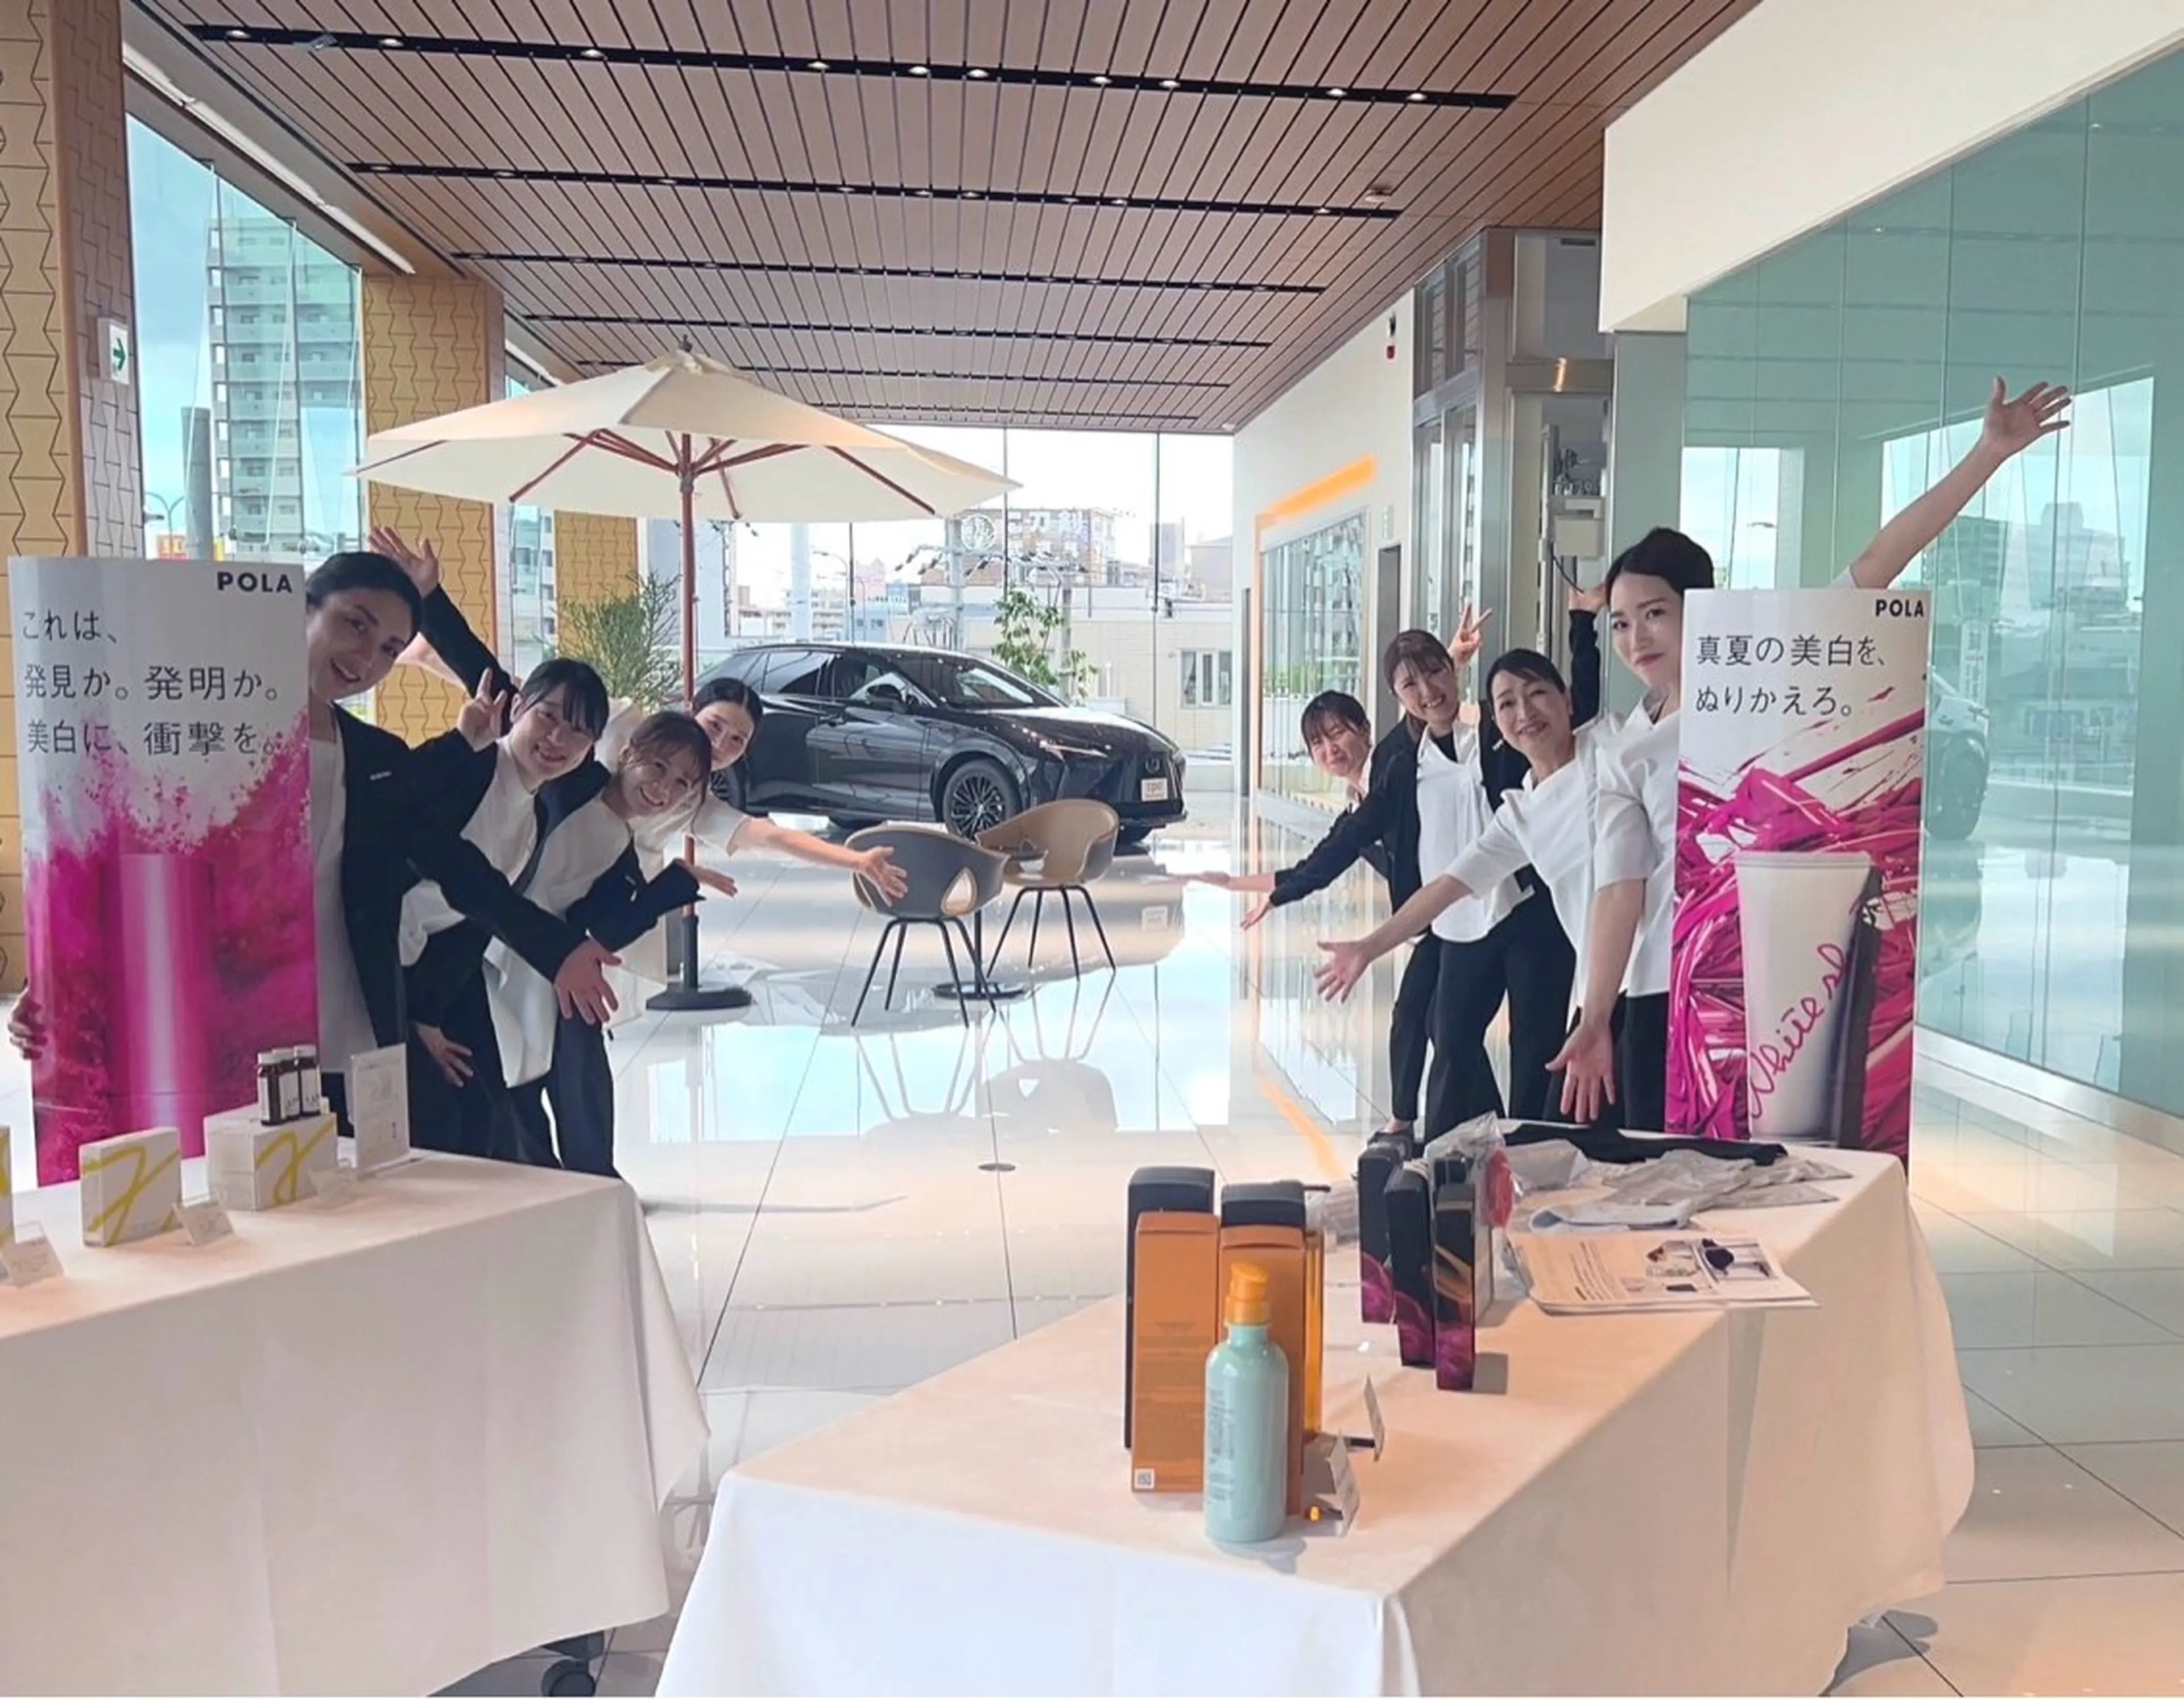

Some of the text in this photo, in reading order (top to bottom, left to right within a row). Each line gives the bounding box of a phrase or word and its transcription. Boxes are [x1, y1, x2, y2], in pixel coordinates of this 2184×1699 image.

[217, 571, 293, 594] POLA
[1875, 599, 1924, 617] POLA
[23, 610, 117, 643] これは、
[1696, 633, 1887, 667] 真夏の美白を、
[24, 664, 278, 701] 発見か。発明か。
[1695, 685, 1852, 717] ぬりかえろ。
[27, 719, 275, 757] 美白に、衝撃を。
